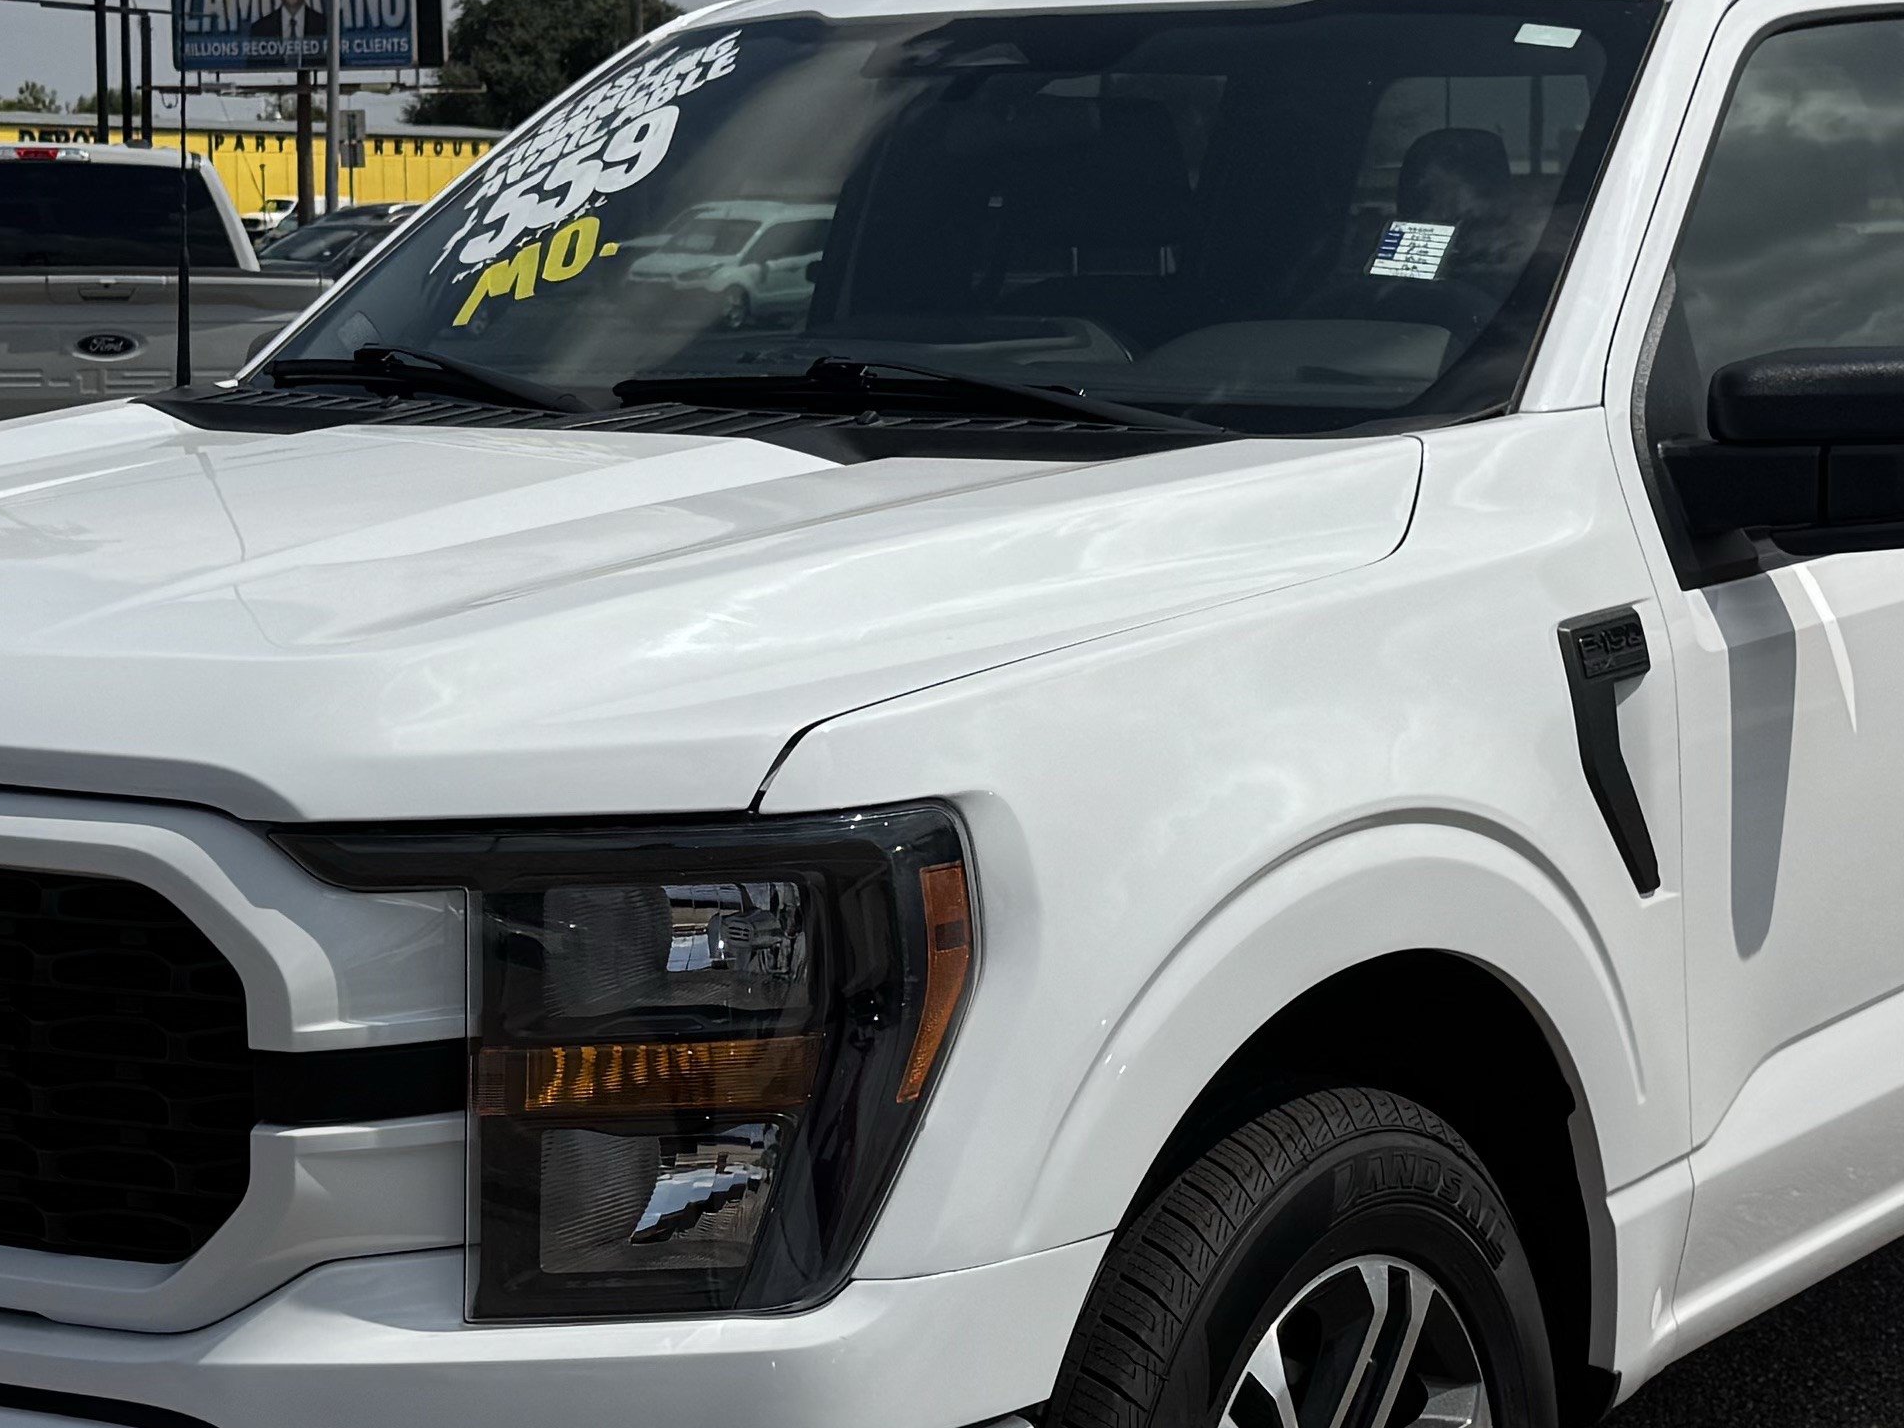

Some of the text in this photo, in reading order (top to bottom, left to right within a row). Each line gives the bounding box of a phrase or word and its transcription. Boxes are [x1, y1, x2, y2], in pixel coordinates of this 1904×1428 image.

[243, 39, 319, 56] RECOVERED
[353, 37, 409, 54] CLIENTS
[214, 133, 287, 153] PART
[452, 216, 620, 327] MO.
